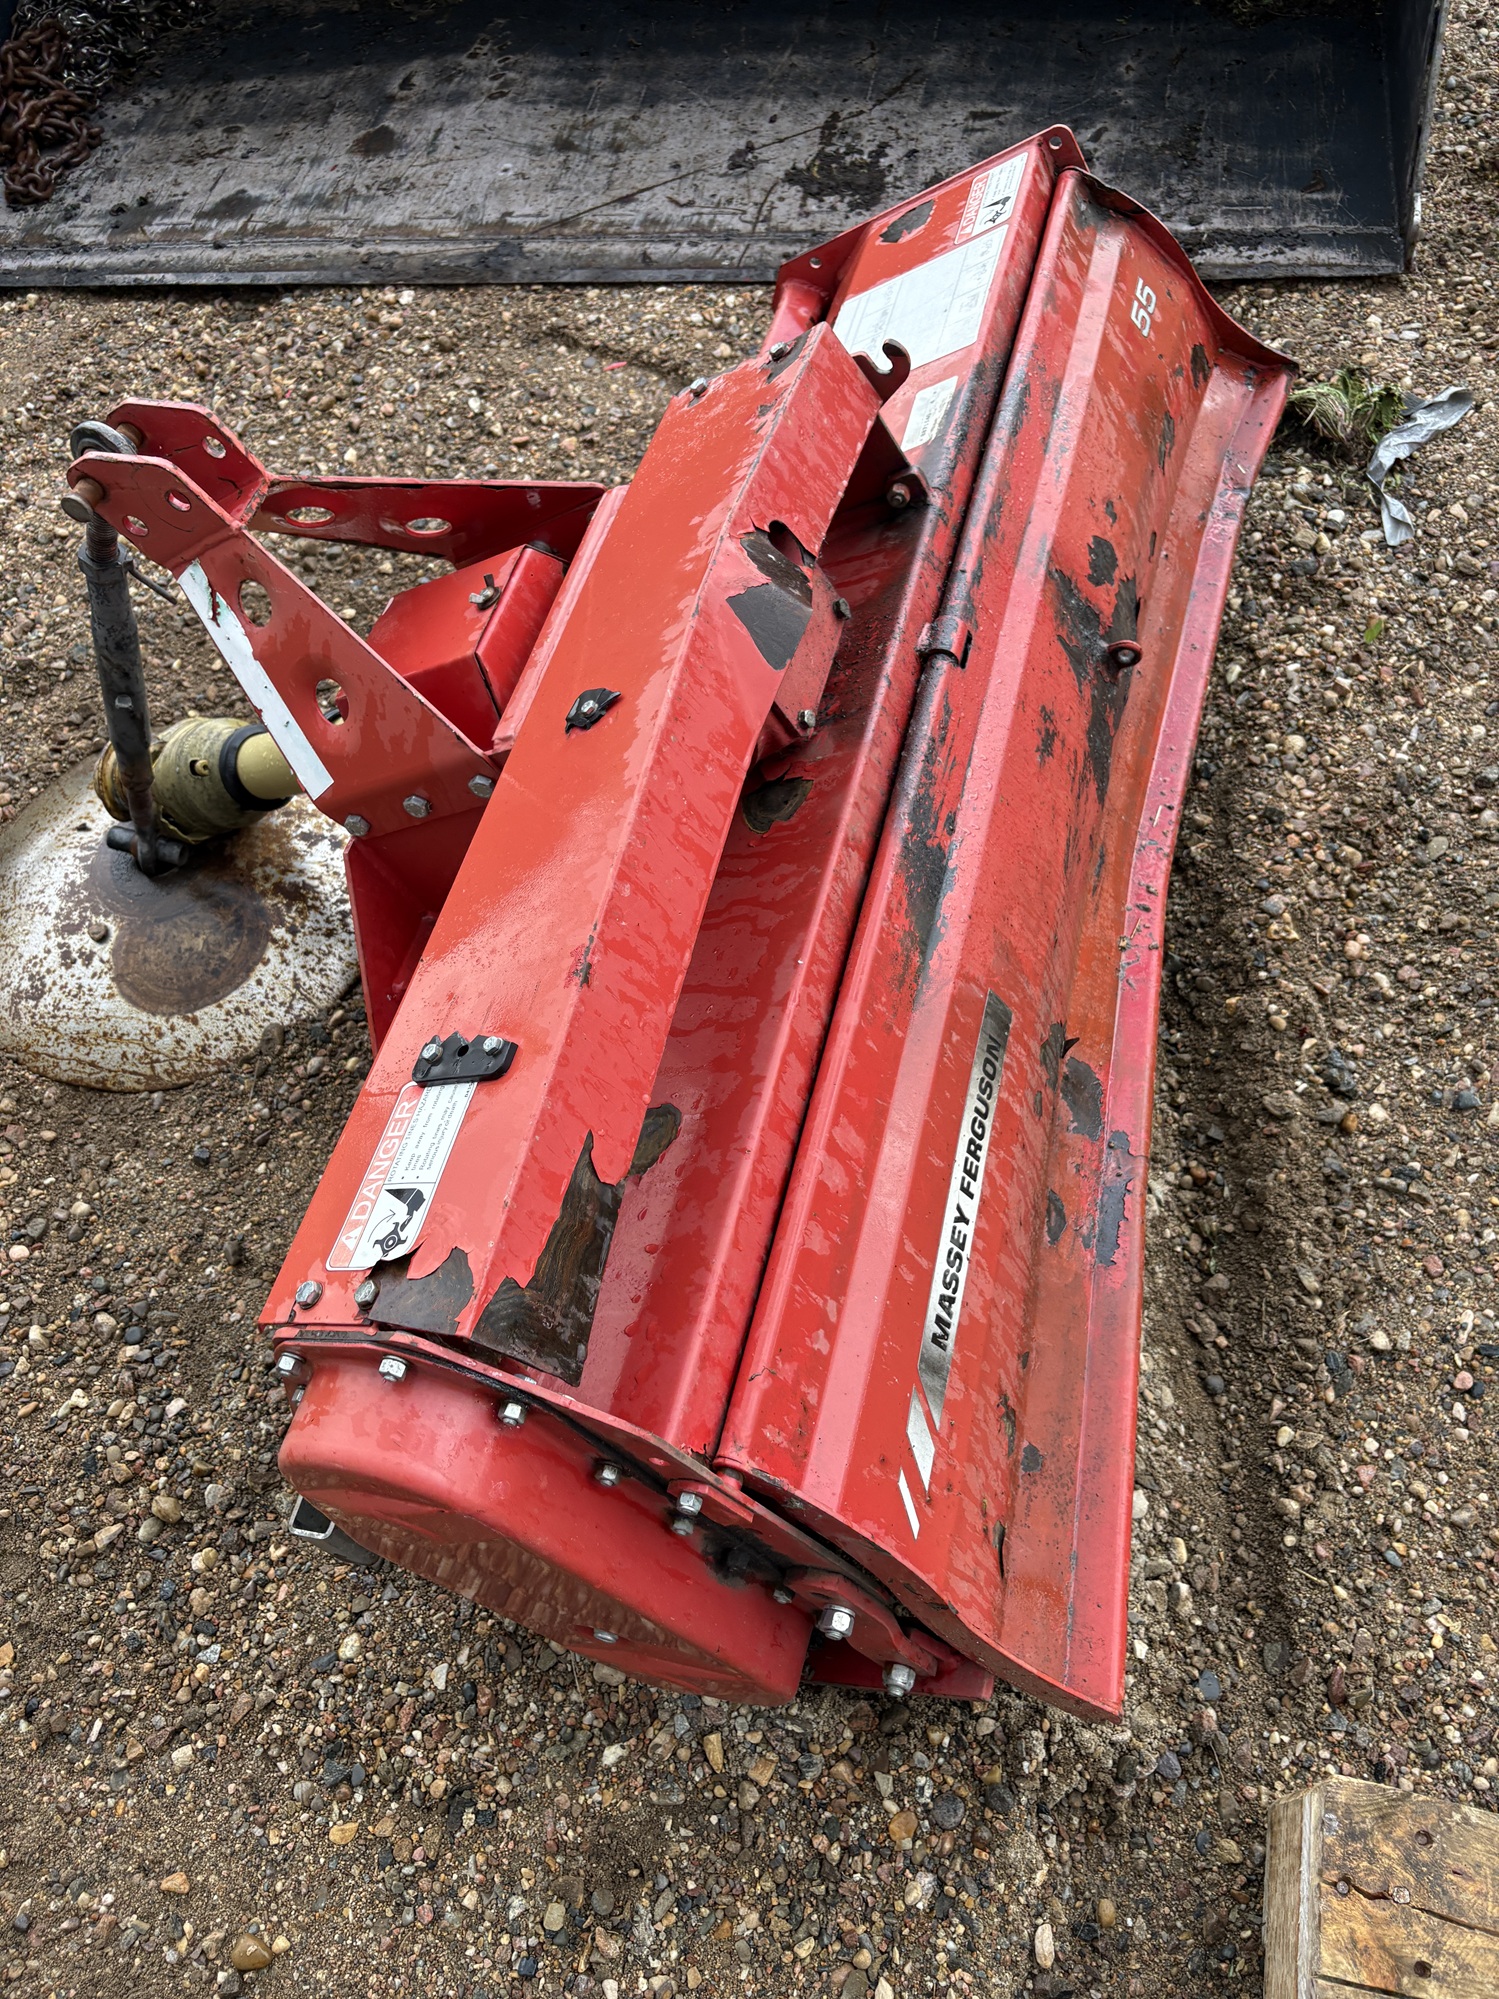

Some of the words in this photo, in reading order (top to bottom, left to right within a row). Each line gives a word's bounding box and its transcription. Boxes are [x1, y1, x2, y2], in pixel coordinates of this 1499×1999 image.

[962, 178, 987, 227] DANGER
[1130, 275, 1156, 338] 55
[351, 1099, 418, 1220] DANGER
[387, 1142, 409, 1182] ROTATING
[405, 1117, 419, 1140] TINES
[405, 1153, 416, 1171] Keep
[415, 1131, 426, 1149] away
[423, 1112, 433, 1128] from
[411, 1154, 422, 1171] tines
[419, 1142, 436, 1171] Rotating
[432, 1123, 443, 1140] tines
[440, 1106, 450, 1121] may
[930, 1203, 970, 1351] MASSEY
[959, 1034, 1002, 1200] FERGUSON
